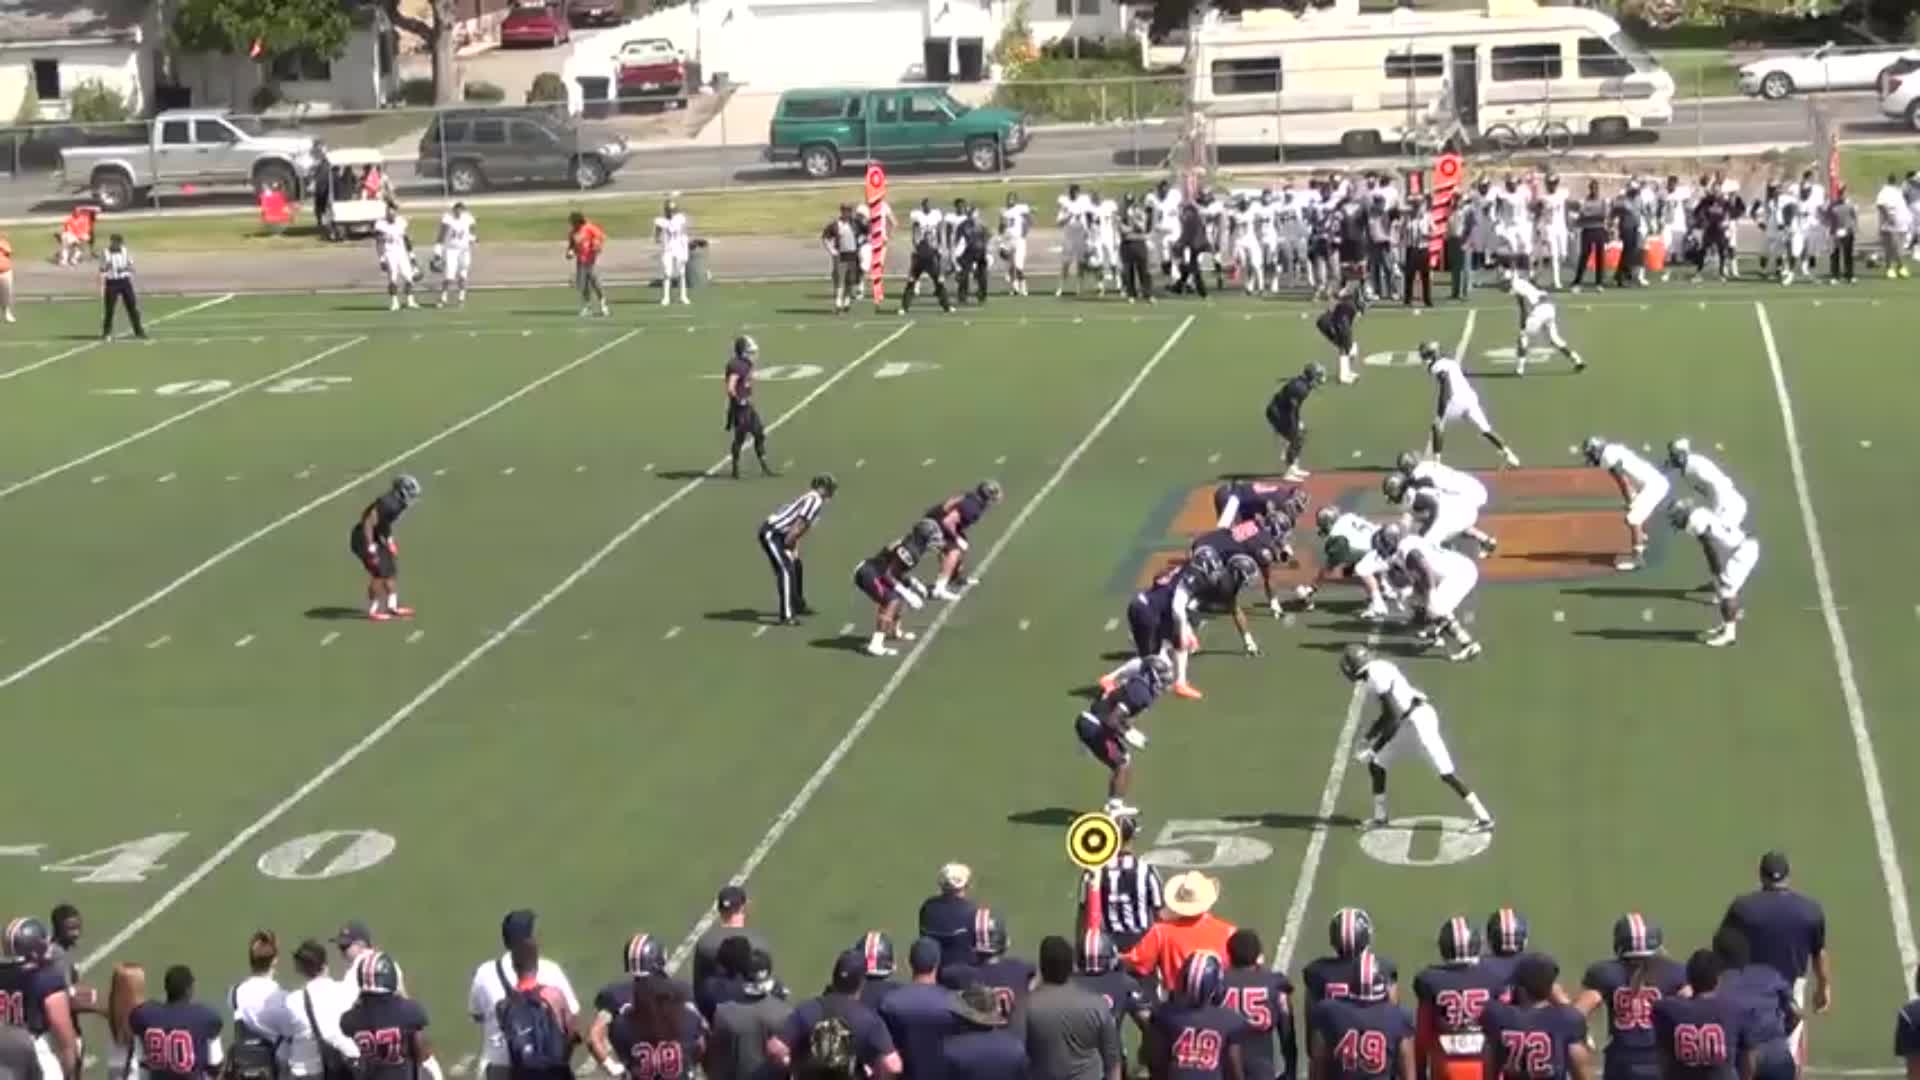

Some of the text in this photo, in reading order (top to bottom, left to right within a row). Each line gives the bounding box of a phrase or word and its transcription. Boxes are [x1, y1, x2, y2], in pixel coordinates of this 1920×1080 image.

[1333, 1028, 1388, 1074] 49
[1501, 1029, 1555, 1077] 72
[1674, 1022, 1728, 1066] 60
